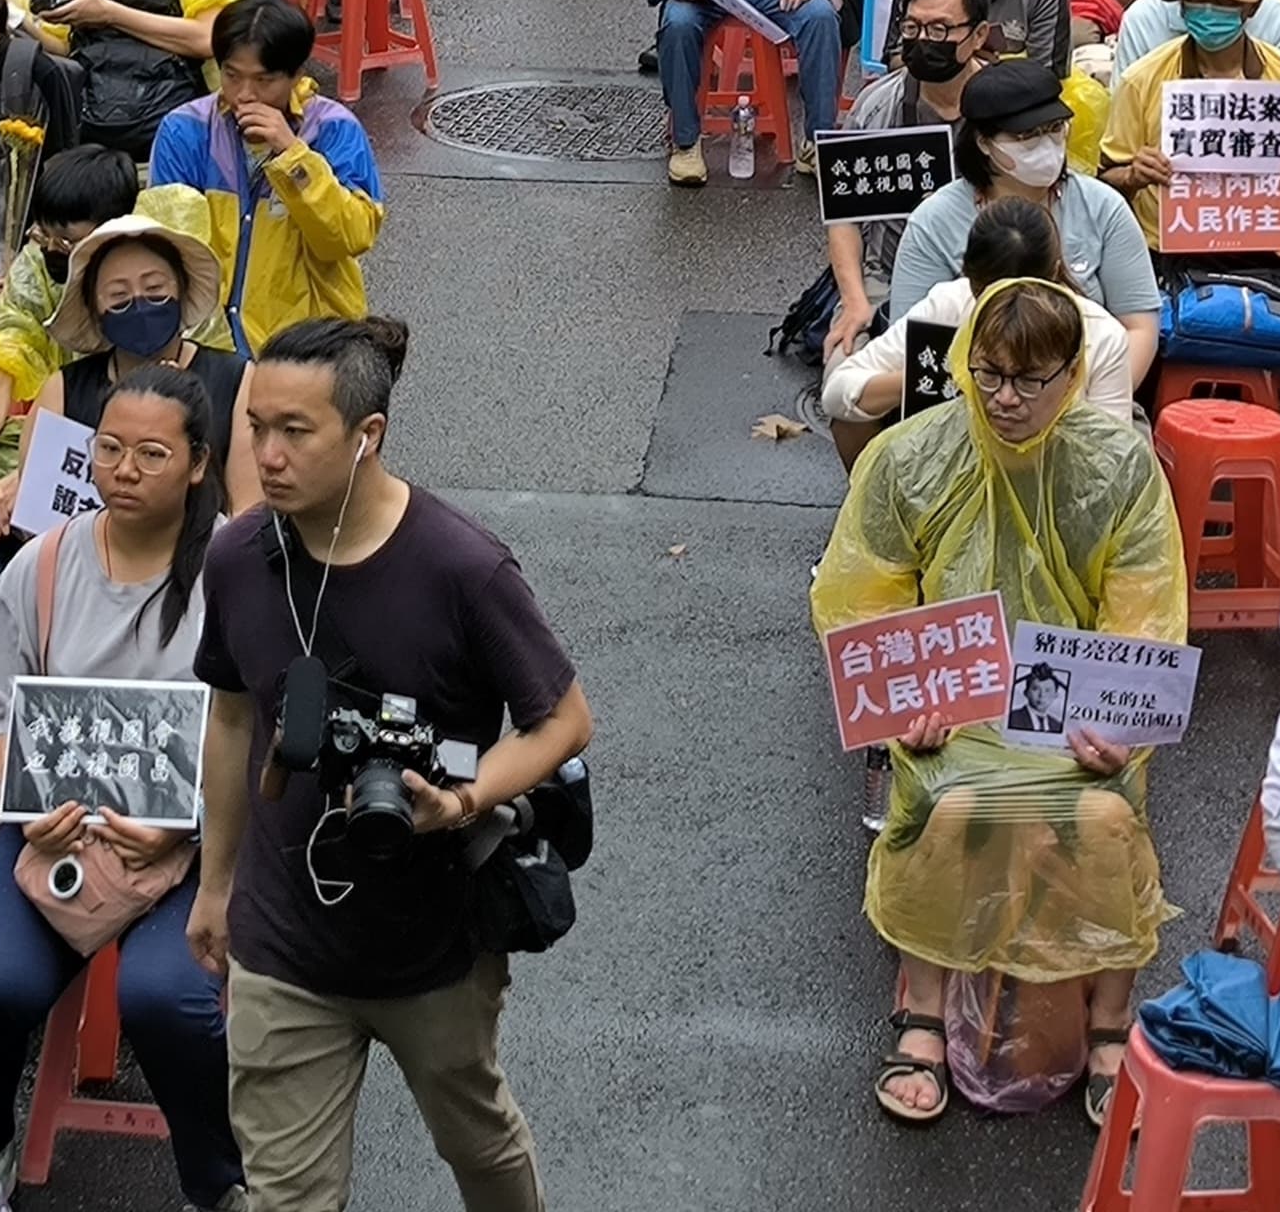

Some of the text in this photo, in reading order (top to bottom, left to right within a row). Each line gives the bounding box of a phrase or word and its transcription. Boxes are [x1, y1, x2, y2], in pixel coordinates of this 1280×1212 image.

[839, 611, 998, 680] 台灣內政
[1034, 632, 1182, 671] 豬哥亮沒有死
[849, 660, 1007, 724] 人民作主
[1099, 688, 1158, 710] 死的是
